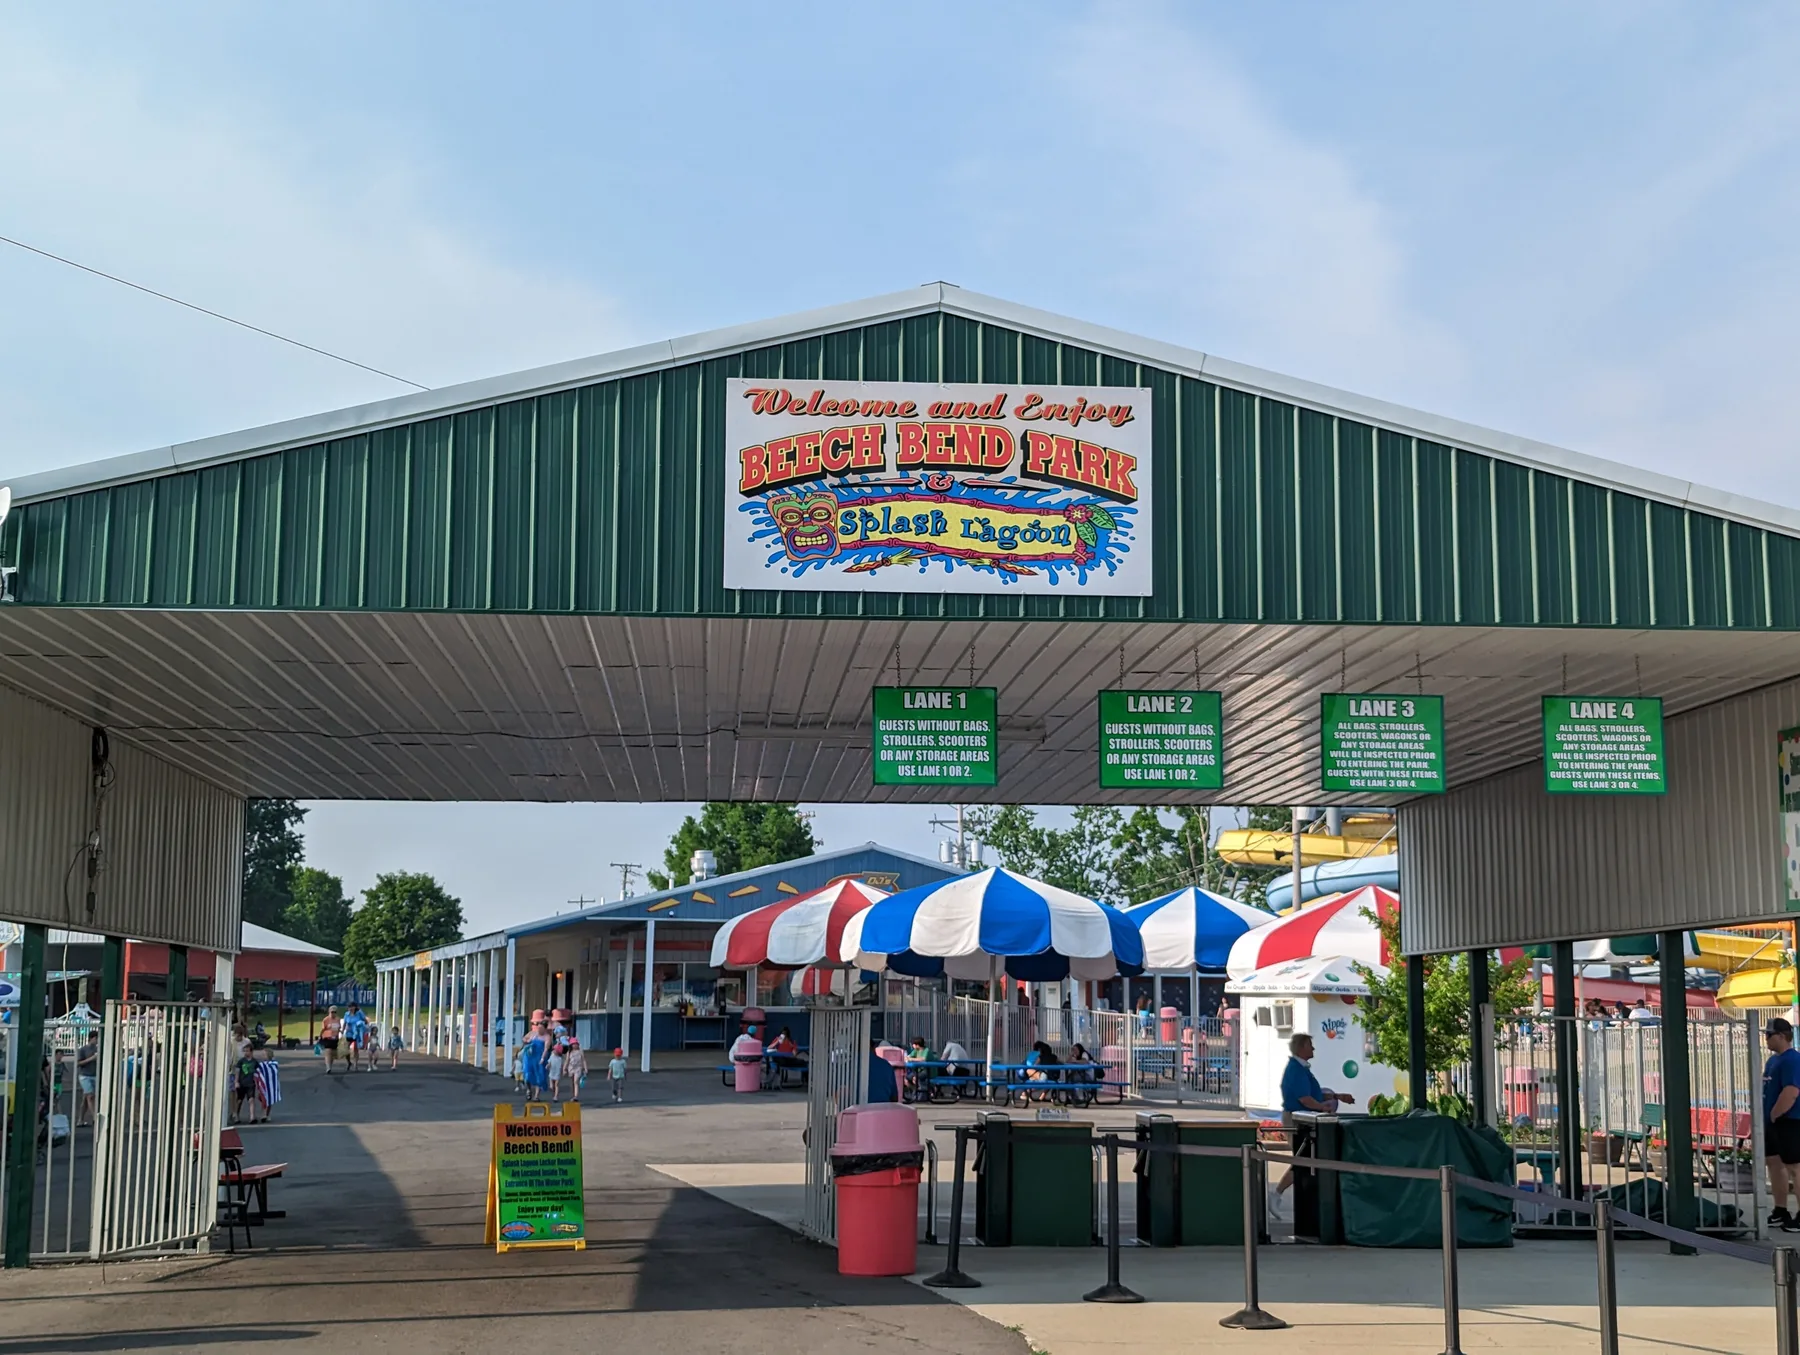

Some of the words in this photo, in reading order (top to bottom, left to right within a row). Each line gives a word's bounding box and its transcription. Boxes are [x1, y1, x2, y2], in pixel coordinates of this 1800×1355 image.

[743, 388, 919, 417] Welcome
[927, 392, 1007, 419] and
[1013, 392, 1134, 427] Enjoy
[740, 423, 886, 496] BEECH
[896, 421, 1016, 471] BEND
[1021, 429, 1138, 503] PARK
[927, 474, 954, 490] &
[839, 505, 947, 540] Splash
[960, 517, 1070, 549] Lagoon
[903, 691, 952, 709] LANE
[957, 692, 966, 709] 1
[1127, 695, 1176, 713] LANE
[1180, 696, 1193, 713] 2
[1349, 699, 1397, 717] LANE
[1401, 700, 1415, 717] 3
[1569, 702, 1617, 719] LANE
[1621, 702, 1635, 719] 4
[879, 720, 915, 731] GUESTS
[917, 720, 961, 731] WITHOUT
[1105, 723, 1141, 735] GUESTS
[1143, 723, 1186, 735] WITHOUT
[1337, 722, 1351, 730] ALL
[1559, 724, 1573, 732] ALL
[938, 735, 987, 746] SCOOTERS
[1380, 732, 1417, 740] WAGONS
[1601, 734, 1638, 742] WAGONS
[1164, 739, 1212, 750] SCOOTERS
[1341, 741, 1357, 749] ANY
[1398, 742, 1425, 750] AREAS
[1562, 743, 1579, 751] ANY
[1580, 743, 1617, 751] STORAGE
[880, 750, 893, 761] OR
[895, 750, 914, 761] ANY
[916, 750, 958, 761] STORAGE
[960, 751, 990, 762] AREAS
[1106, 753, 1120, 765] OR
[1121, 753, 1140, 765] ANY
[1142, 753, 1183, 765] STORAGE
[1185, 754, 1215, 766] AREAS
[1329, 750, 1349, 758] WILL
[1363, 751, 1409, 759] INSPECTED
[1552, 752, 1571, 760] WILL
[1585, 753, 1630, 761] INSPECTED
[1631, 753, 1657, 761] PRIOR
[1348, 760, 1388, 768] ENTERING
[1406, 761, 1430, 769] PARK.
[1570, 762, 1610, 770] ENTERING
[1611, 762, 1626, 770] THE
[898, 765, 916, 776] USE
[918, 765, 940, 776] LANE
[942, 766, 947, 776] 1
[949, 765, 962, 776] OR
[964, 766, 972, 777] 2.
[1124, 768, 1142, 780] USE
[1144, 768, 1166, 780] LANE
[1168, 769, 1173, 780] 1
[1174, 769, 1188, 780] OR
[1189, 769, 1198, 780] 2.
[1327, 769, 1359, 777] GUESTS
[1385, 770, 1410, 778] THESE
[1550, 771, 1581, 779] GUESTS
[1607, 772, 1632, 780] THESE
[1349, 779, 1365, 787] USE
[1367, 779, 1387, 787] LANE
[1589, 781, 1609, 789] LANE
[1610, 781, 1617, 789] 3
[1618, 781, 1630, 789] OR
[1631, 781, 1639, 789] 4.
[505, 1124, 558, 1137] Welcome
[560, 1124, 572, 1136] to
[504, 1141, 539, 1154] Beech
[541, 1140, 573, 1153] Bend!
[518, 1205, 535, 1213] Enjoy
[551, 1204, 564, 1212] day!
